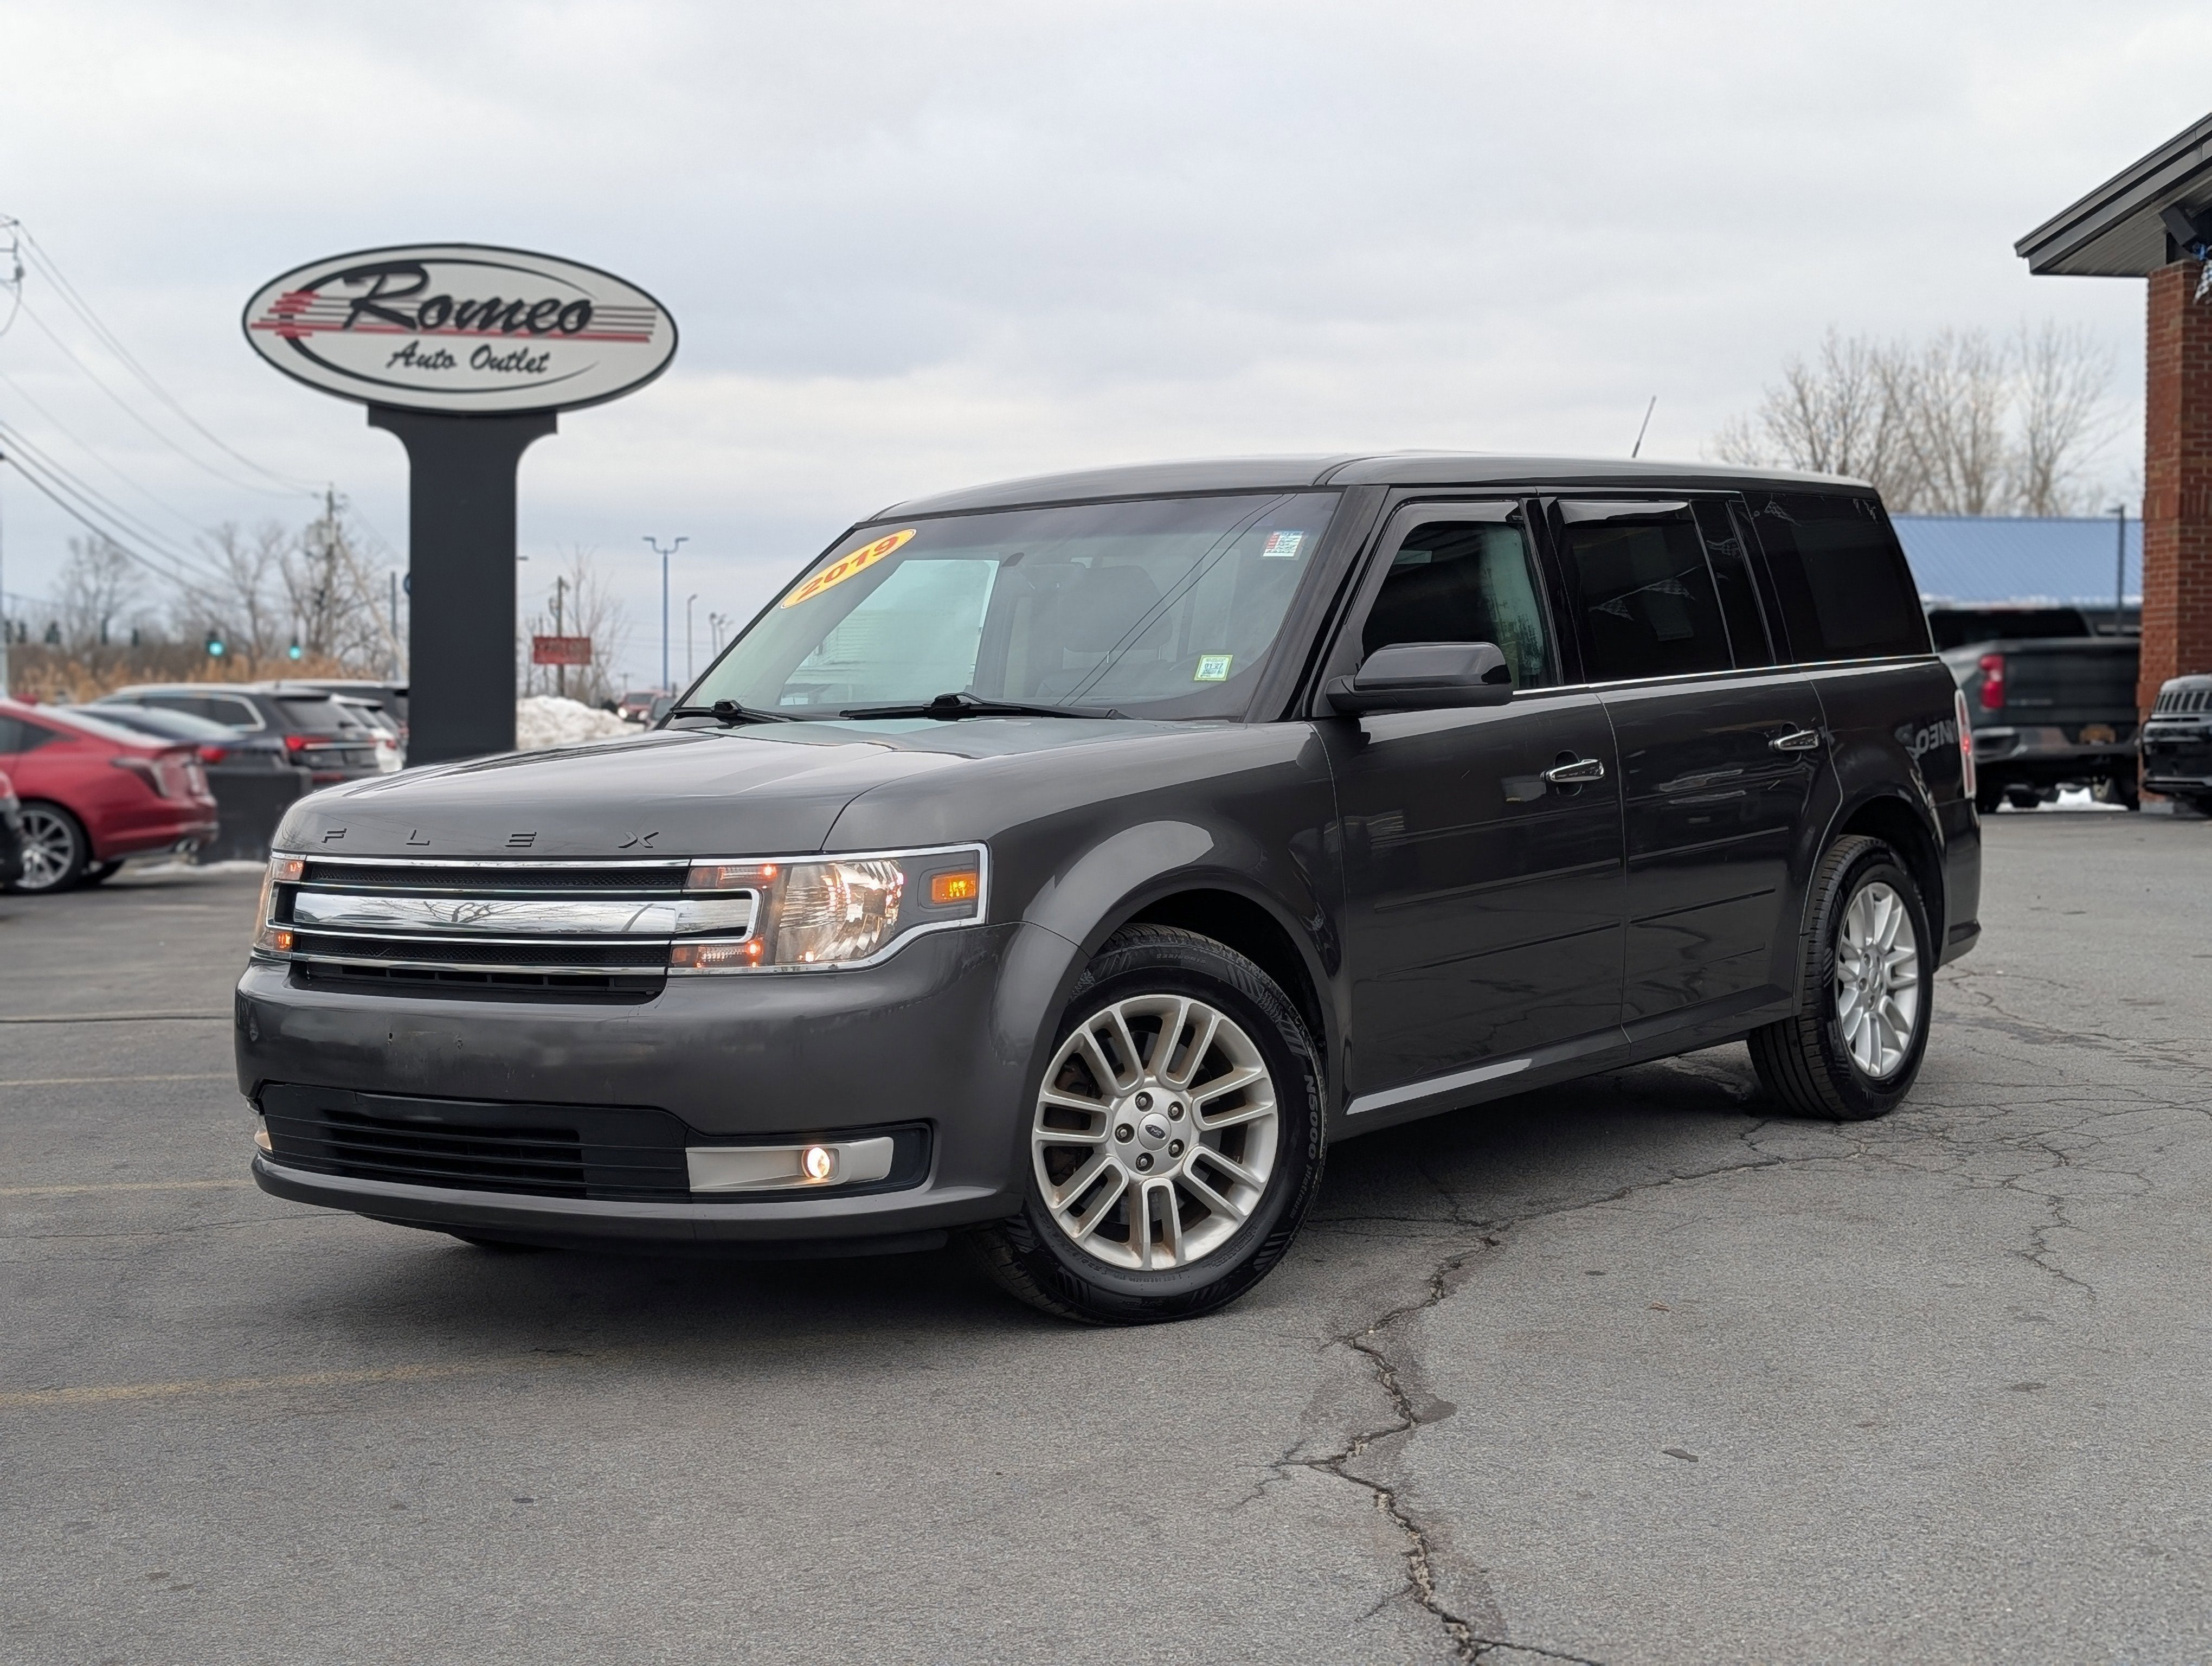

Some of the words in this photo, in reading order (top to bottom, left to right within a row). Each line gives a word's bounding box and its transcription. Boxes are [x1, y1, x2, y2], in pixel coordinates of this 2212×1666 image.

[342, 263, 593, 334] Romeo
[386, 339, 456, 369] Auto
[470, 343, 550, 374] Outlet
[795, 536, 899, 601] 2019
[321, 828, 659, 849] FLEX
[1303, 1074, 1318, 1159] N5000
